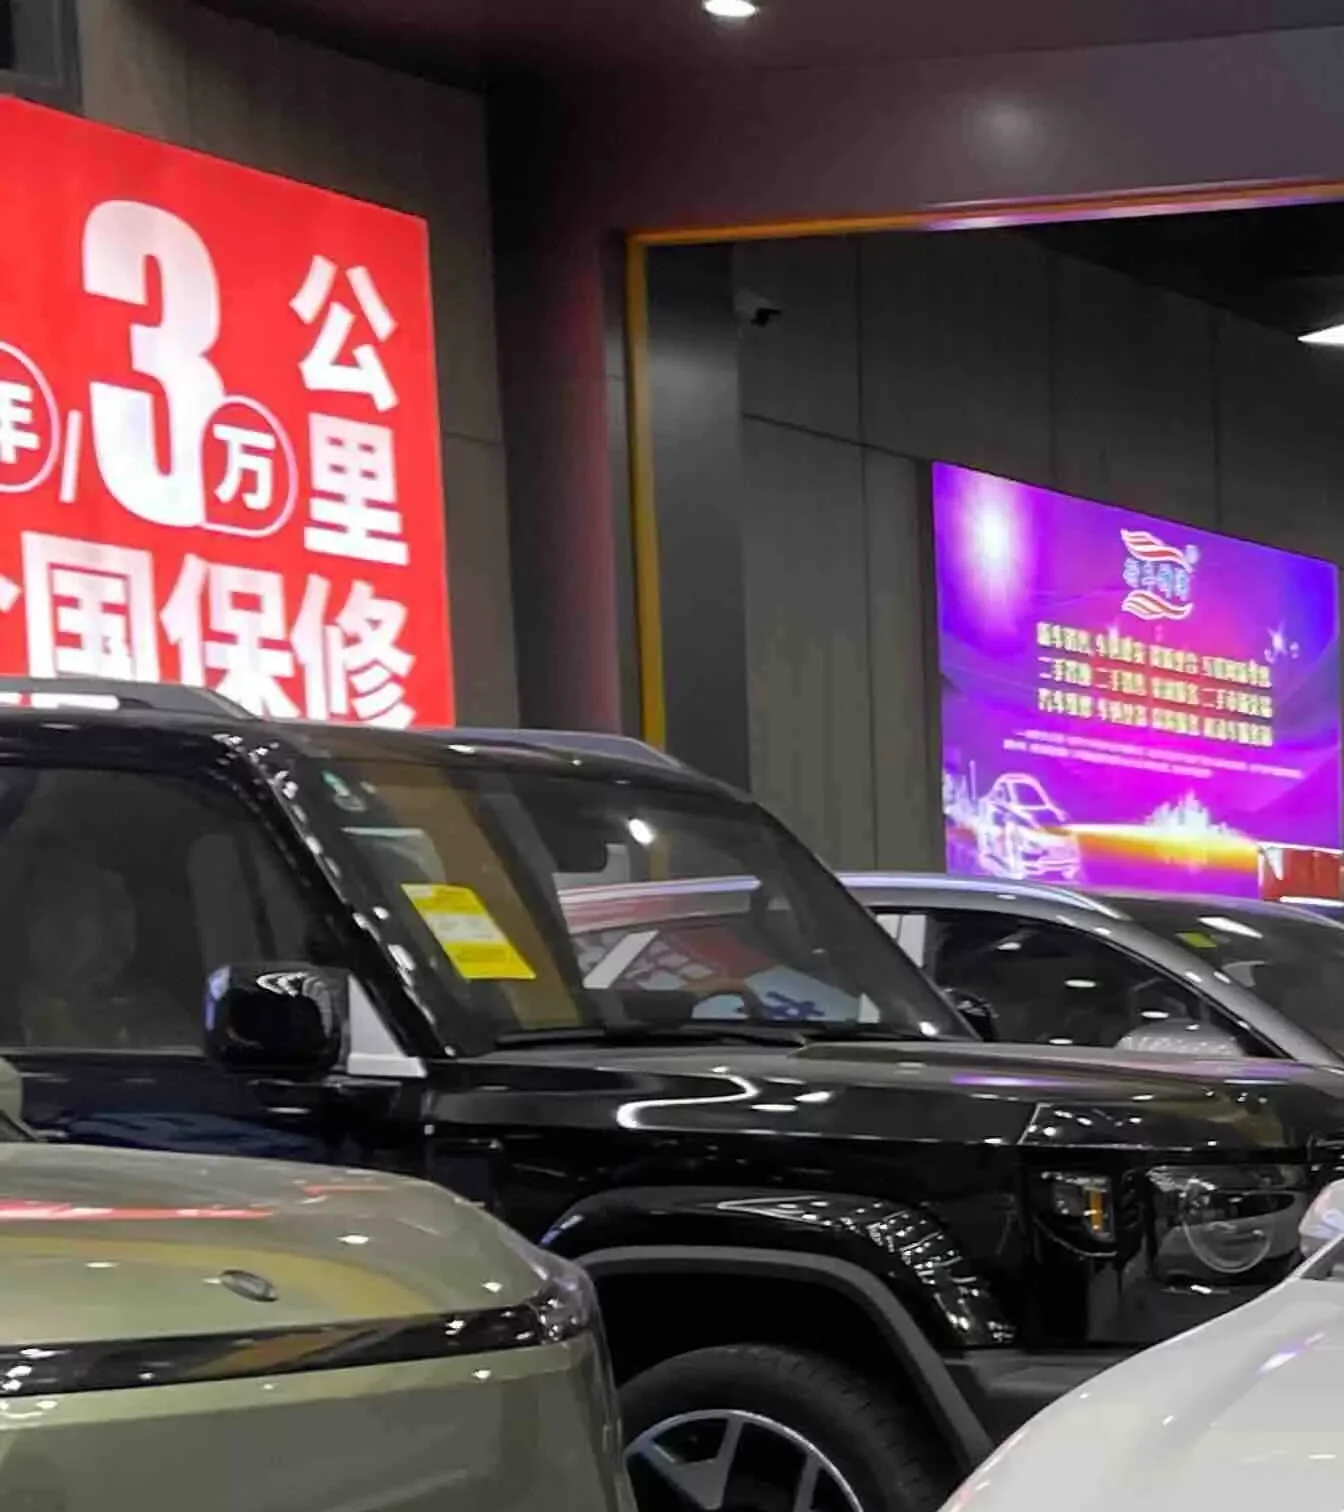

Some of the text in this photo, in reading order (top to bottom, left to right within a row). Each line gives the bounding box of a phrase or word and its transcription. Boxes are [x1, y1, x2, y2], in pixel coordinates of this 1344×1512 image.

[82, 200, 226, 527] 3
[212, 423, 276, 508] 万
[289, 255, 409, 567] 公里
[0, 531, 416, 730] 国保修
